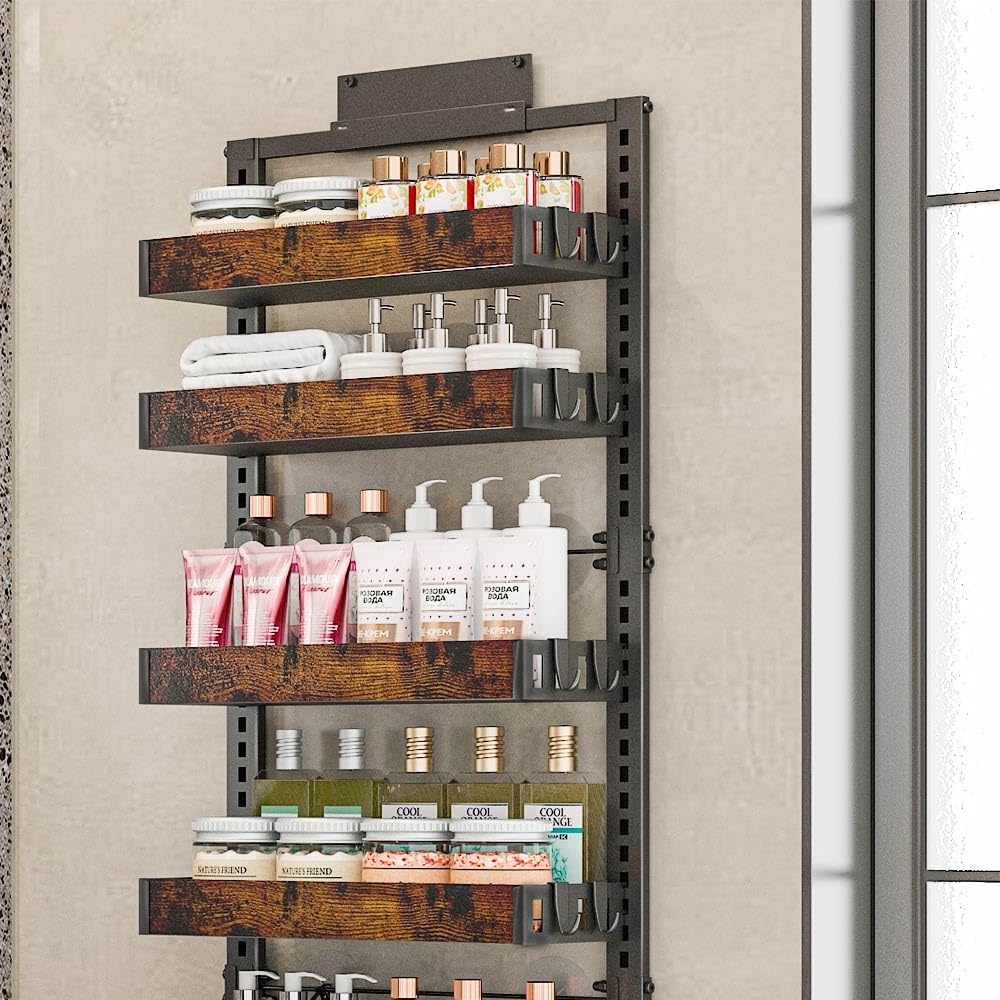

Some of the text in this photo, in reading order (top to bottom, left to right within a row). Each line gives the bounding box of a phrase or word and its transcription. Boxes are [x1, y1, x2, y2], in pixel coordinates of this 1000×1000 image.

[396, 807, 422, 817] COOL
[467, 807, 492, 817] COOL
[539, 807, 566, 818] COOL
[221, 866, 247, 874] FRIEND
[306, 867, 333, 876] FRIEND
